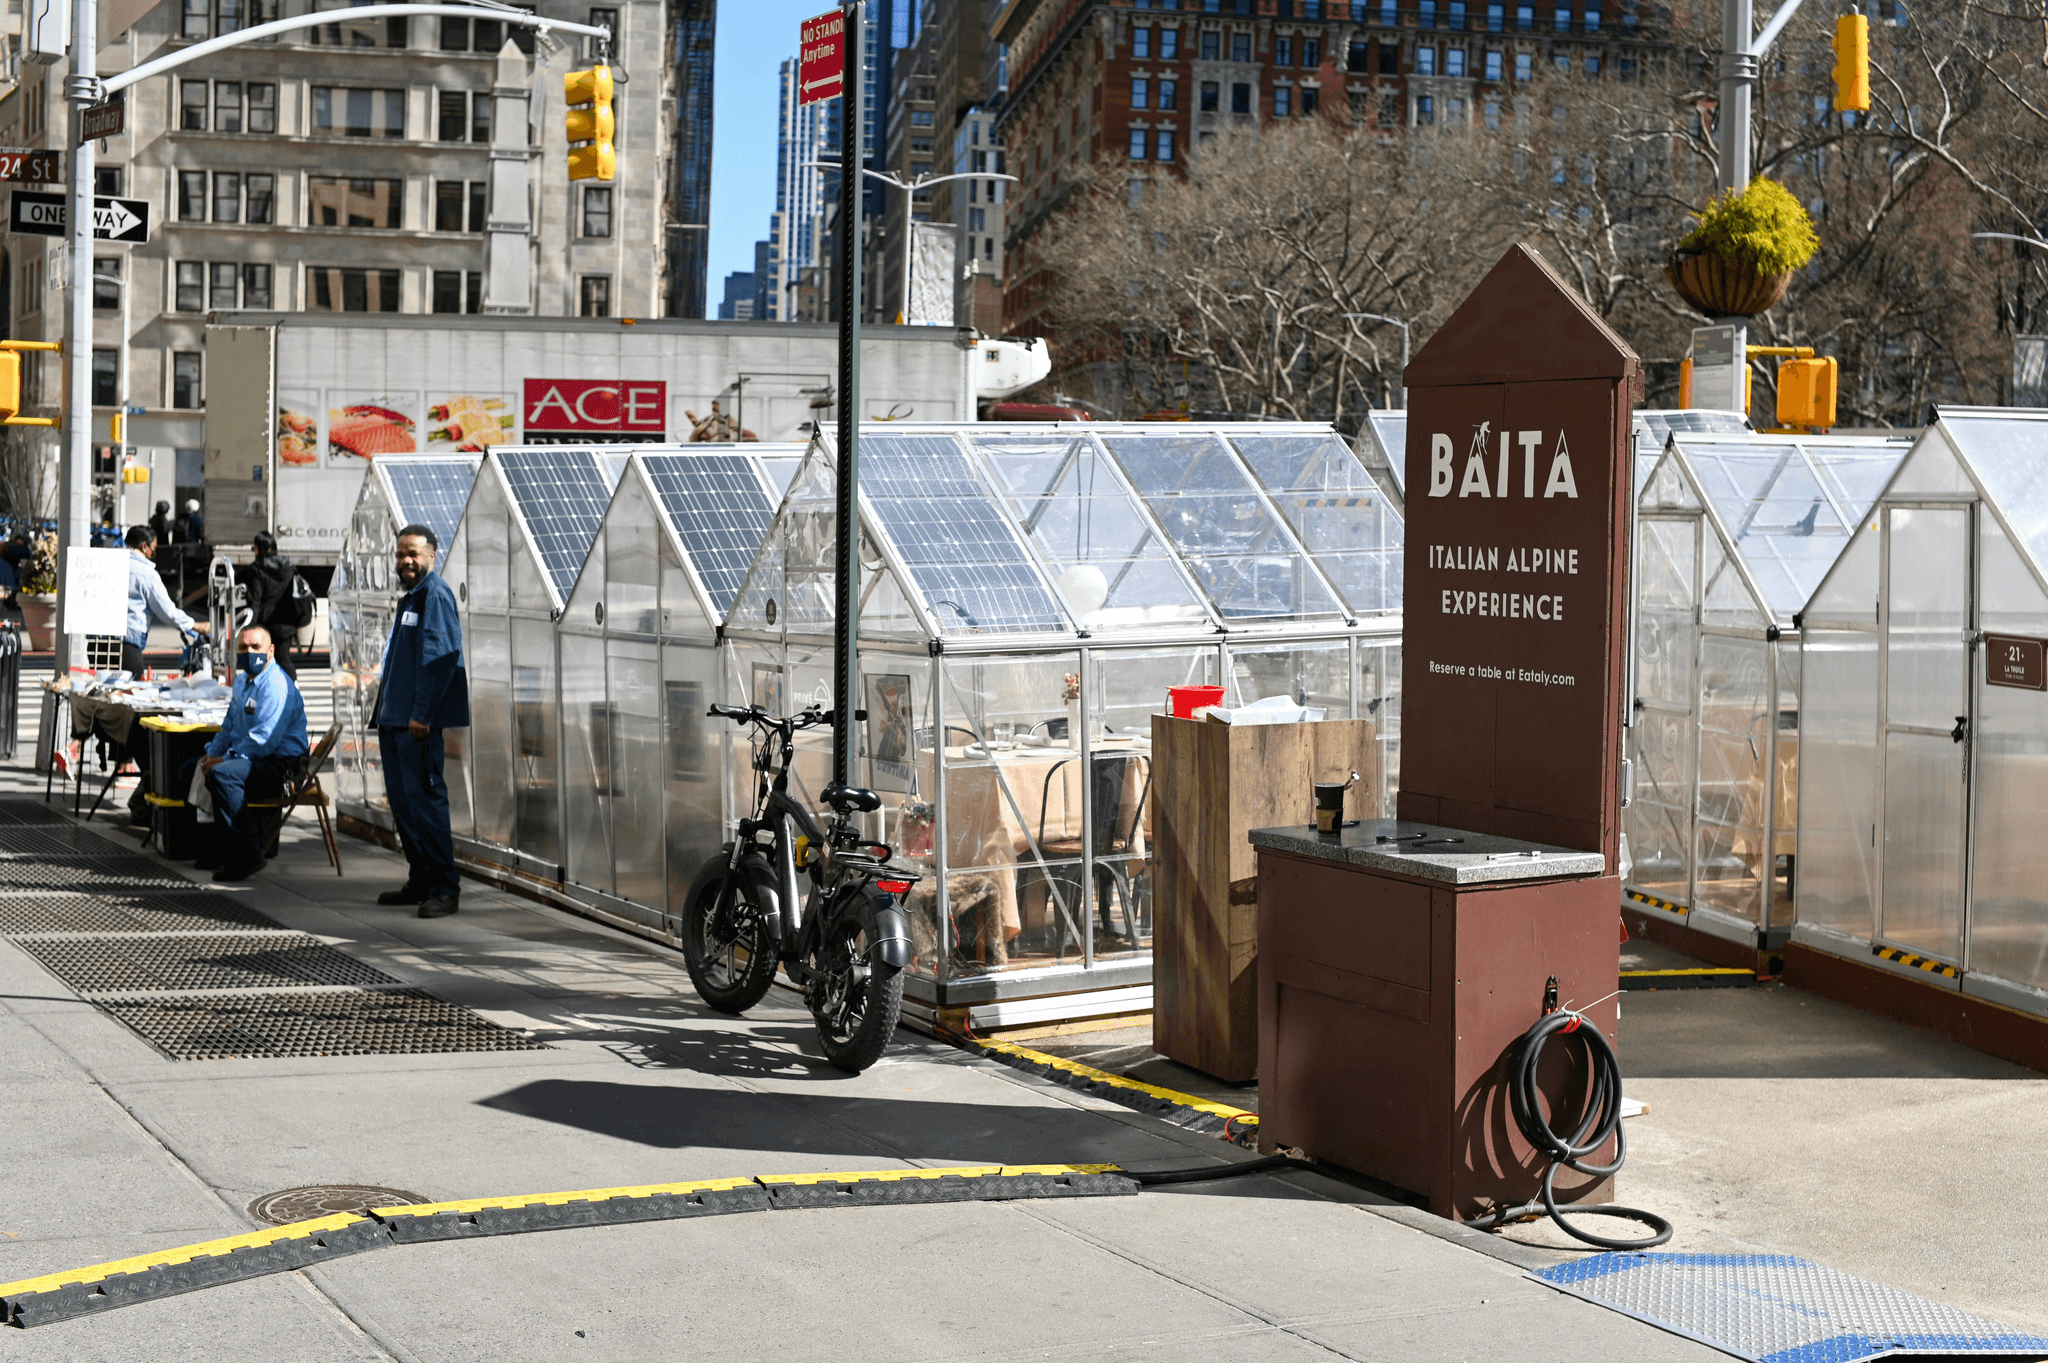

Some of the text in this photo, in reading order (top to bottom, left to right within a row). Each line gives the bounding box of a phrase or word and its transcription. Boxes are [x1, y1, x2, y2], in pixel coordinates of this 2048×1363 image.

[803, 27, 815, 44] NO
[803, 43, 835, 64] Anytime
[85, 109, 120, 134] Broadway
[0, 156, 51, 180] 24 St
[31, 204, 66, 223] ONE
[528, 385, 661, 425] ACE
[1428, 428, 1578, 498] BAITA
[1429, 545, 1578, 575] ITALIAN ALPINE
[1442, 589, 1563, 621] EXPERIENCE
[1429, 660, 1575, 687] Reserve a table at Eataly.com
[793, 691, 813, 704] PRIVÉ
